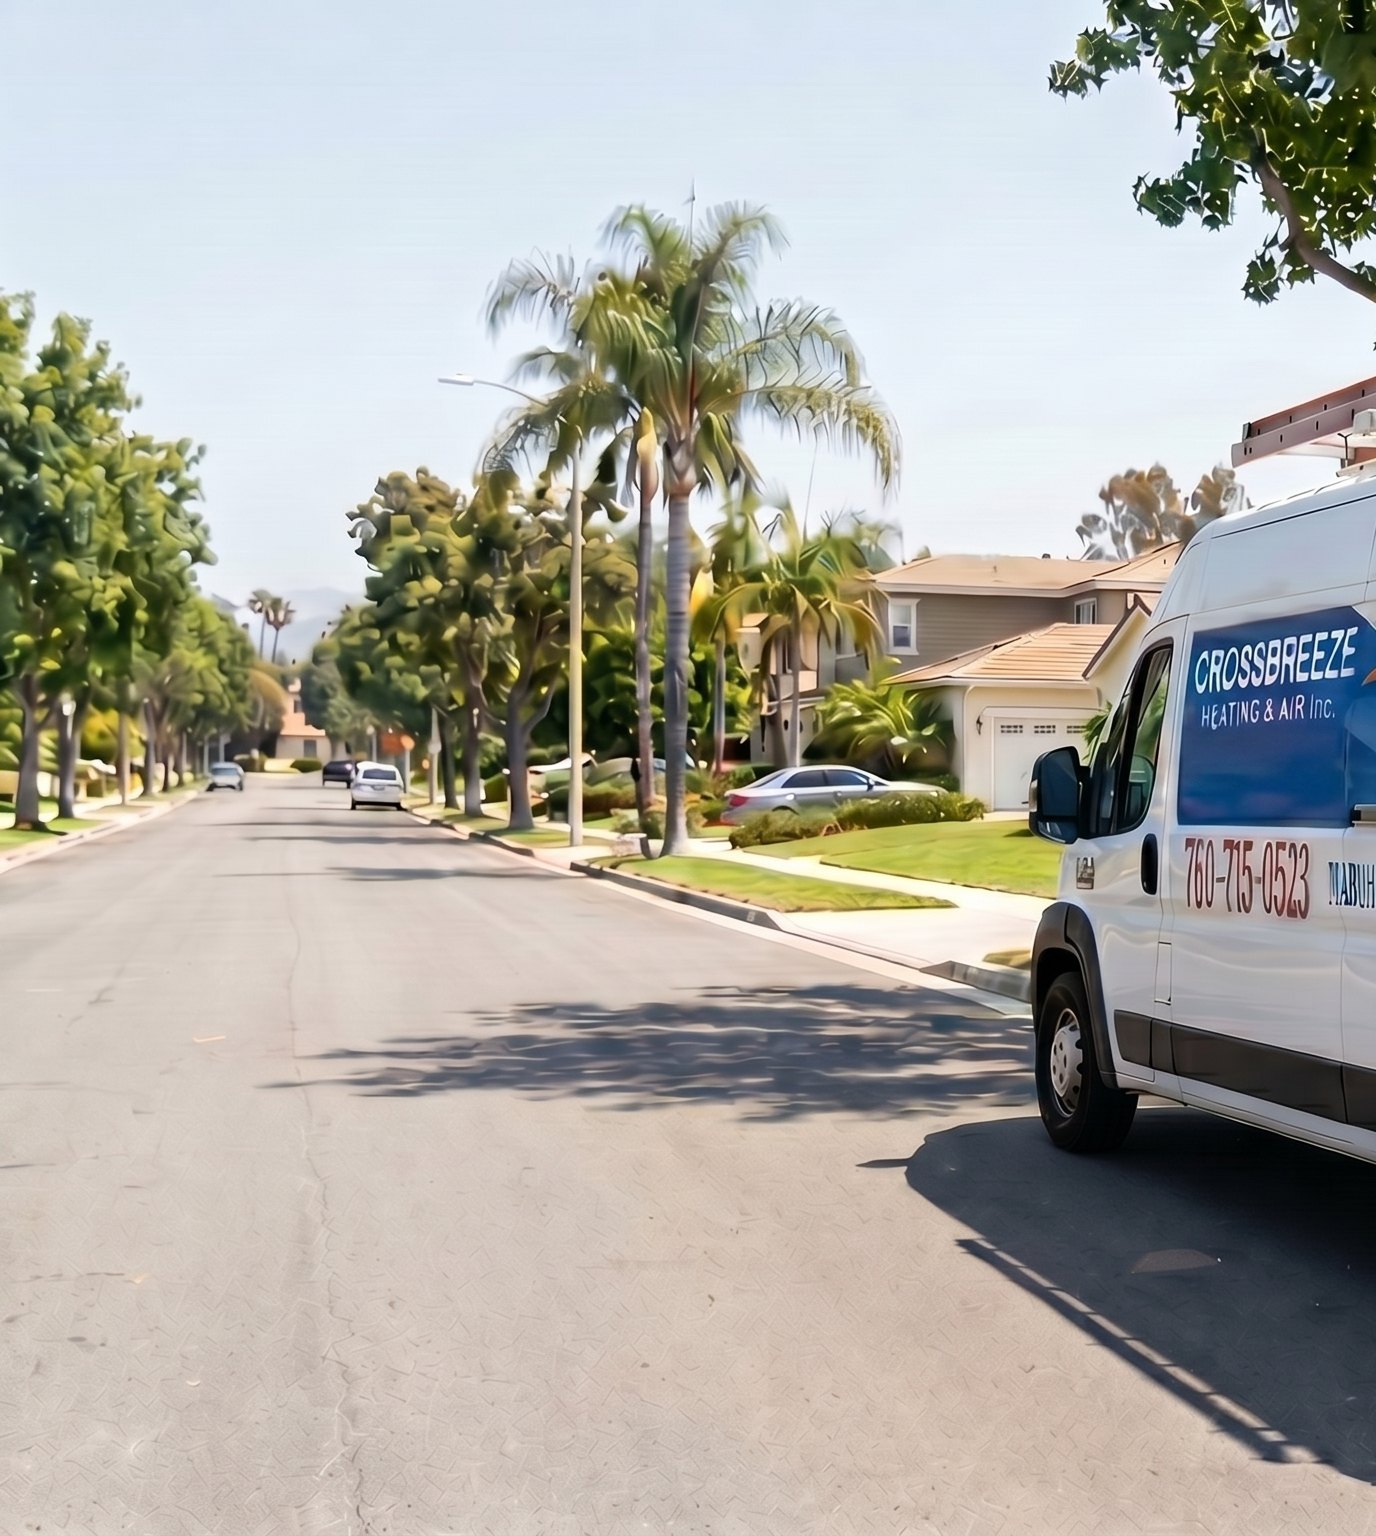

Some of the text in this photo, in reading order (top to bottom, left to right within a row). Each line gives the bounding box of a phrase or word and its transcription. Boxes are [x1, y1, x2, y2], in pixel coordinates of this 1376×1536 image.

[1195, 626, 1358, 694] CROSSBREEZE
[1201, 694, 1335, 730] HEATING & AIR Inc.
[1185, 838, 1310, 919] 760-715-0523
